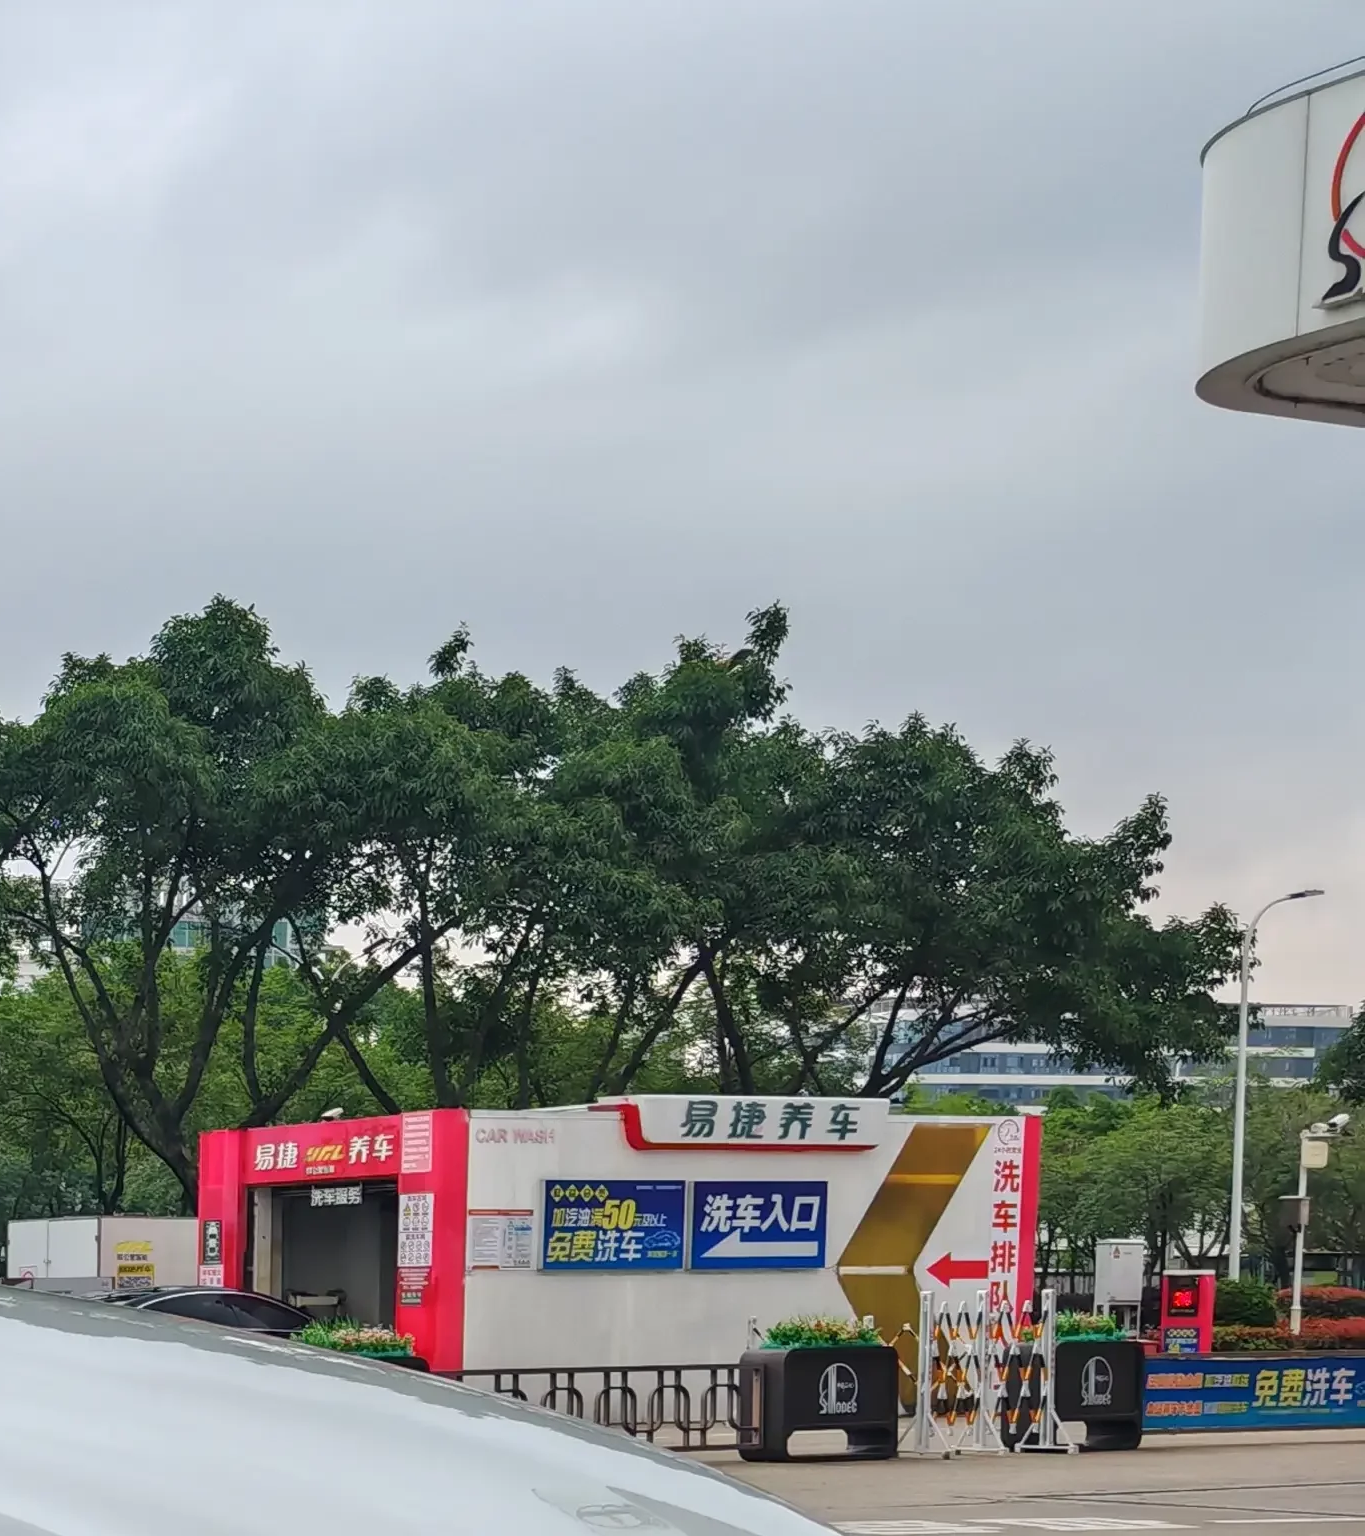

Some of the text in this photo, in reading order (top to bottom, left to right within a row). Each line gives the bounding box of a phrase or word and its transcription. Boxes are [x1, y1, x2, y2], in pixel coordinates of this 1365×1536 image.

[475, 1128, 555, 1144] CAR WASH
[680, 1100, 861, 1141] 易捷养车
[254, 1142, 299, 1171] 易捷
[348, 1133, 395, 1164] 养车
[310, 1184, 363, 1207] 洗车服务
[699, 1194, 821, 1233] 洗车入口
[546, 1230, 645, 1262] 免费洗车
[1252, 1367, 1356, 1407] 免费洗车
